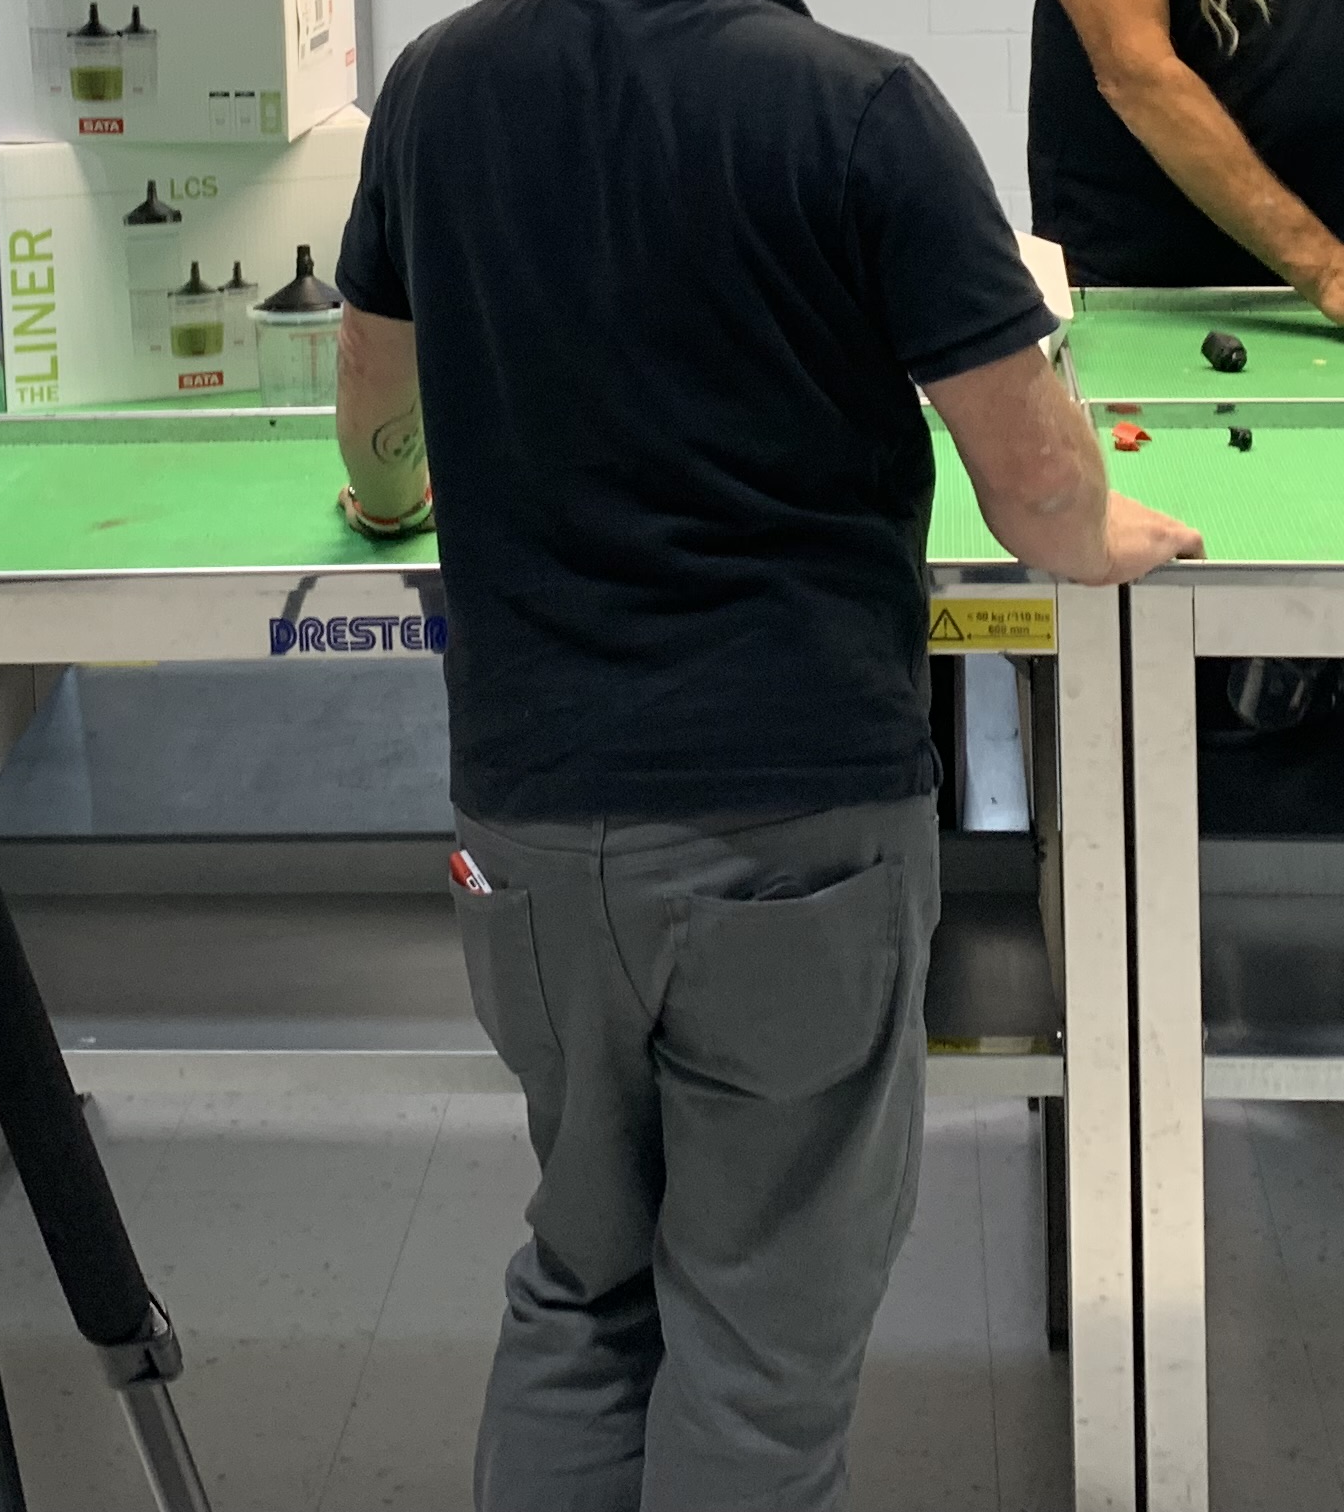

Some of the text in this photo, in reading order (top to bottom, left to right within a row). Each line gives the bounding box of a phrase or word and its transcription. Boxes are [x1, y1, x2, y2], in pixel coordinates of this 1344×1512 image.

[170, 176, 218, 200] LCS
[9, 228, 59, 383] LINER
[17, 385, 59, 403] THE
